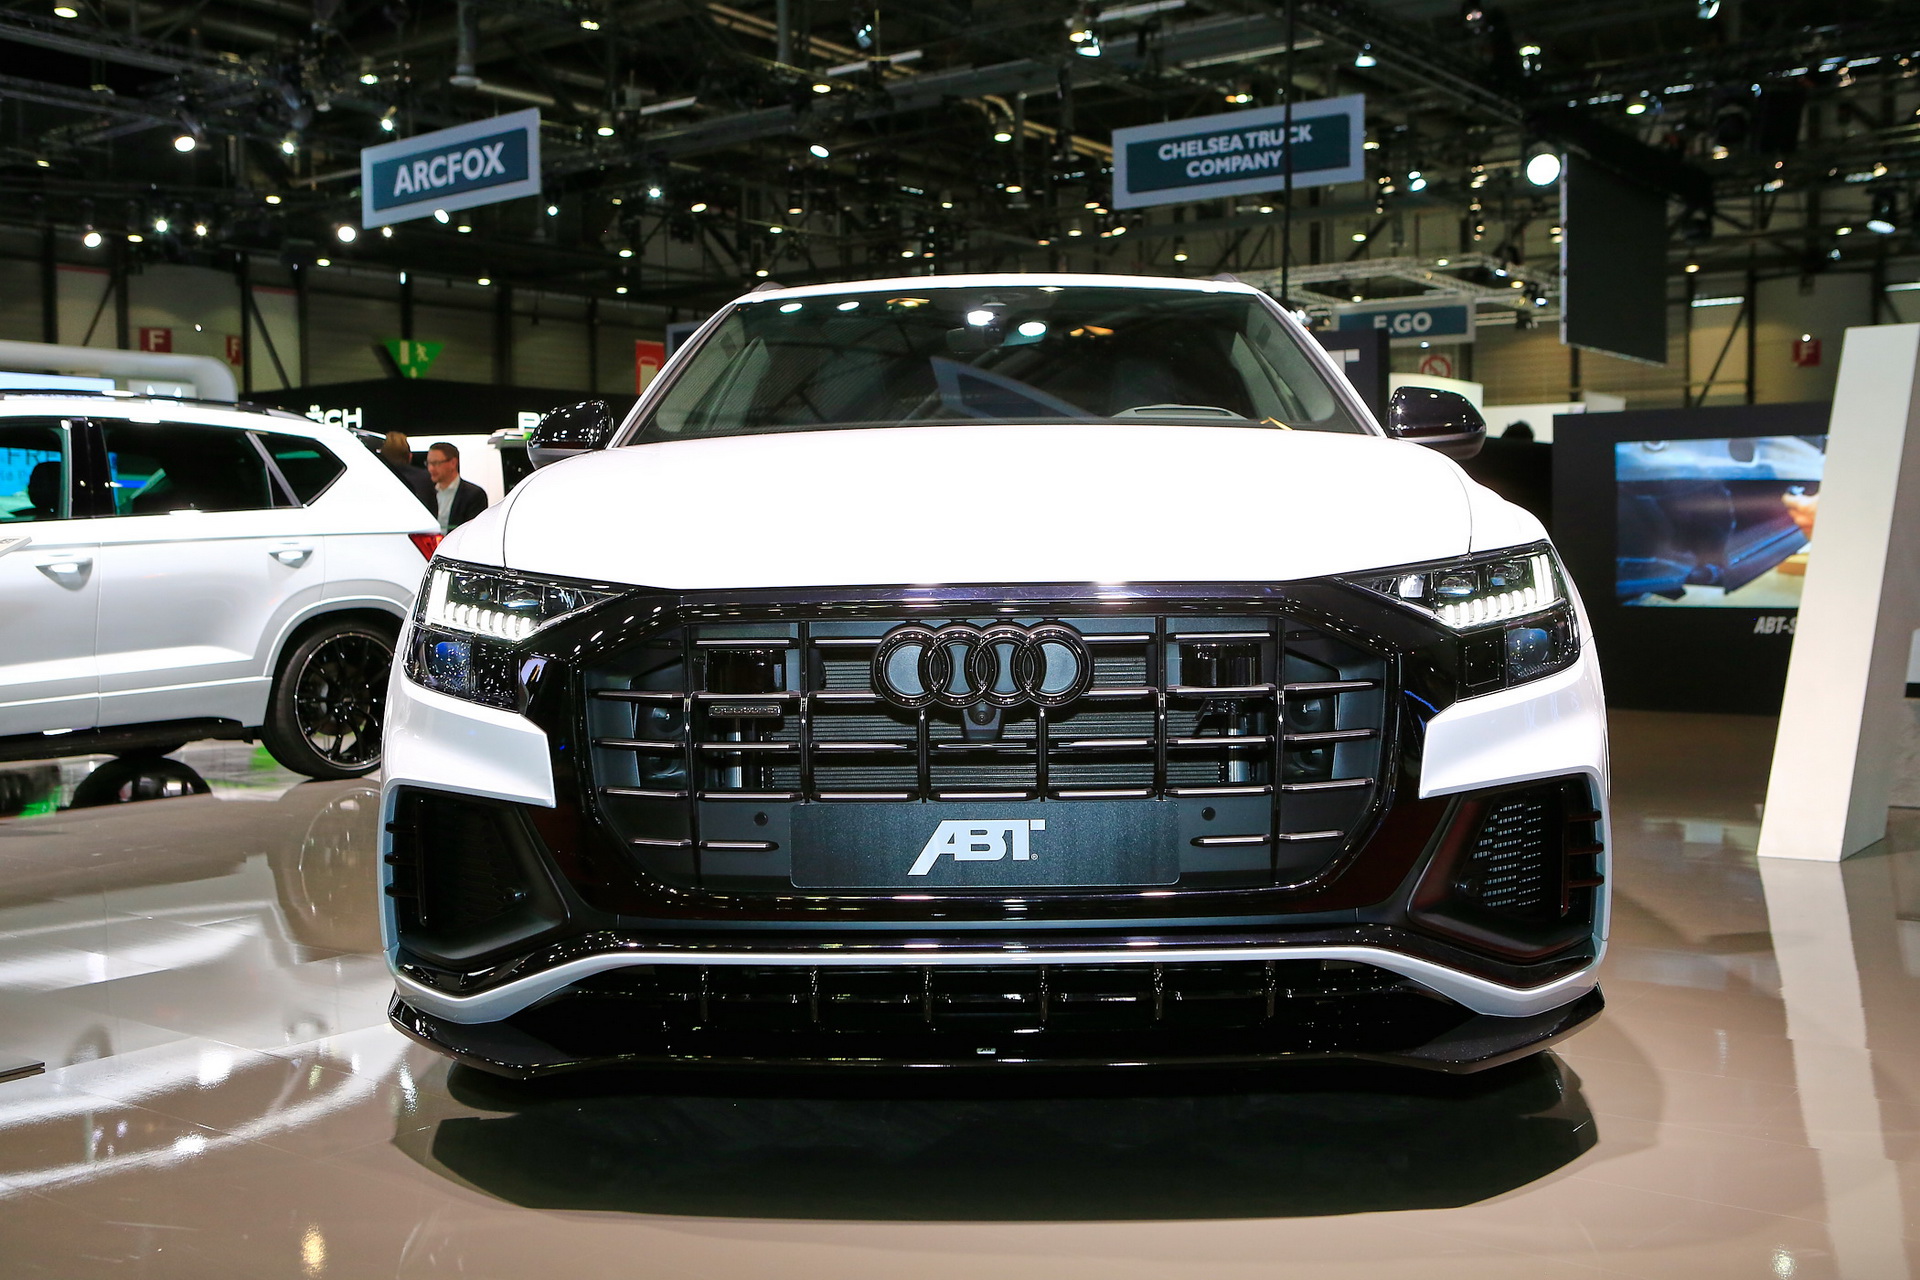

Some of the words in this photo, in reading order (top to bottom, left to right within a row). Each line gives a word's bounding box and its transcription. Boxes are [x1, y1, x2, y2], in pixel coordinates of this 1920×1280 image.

[1158, 134, 1244, 161] CHELSEA
[1245, 124, 1313, 148] TRUCK
[393, 142, 505, 197] ARCFOX
[1186, 150, 1283, 178] COMPANY
[148, 330, 165, 351] F
[907, 819, 1046, 876] ABT
